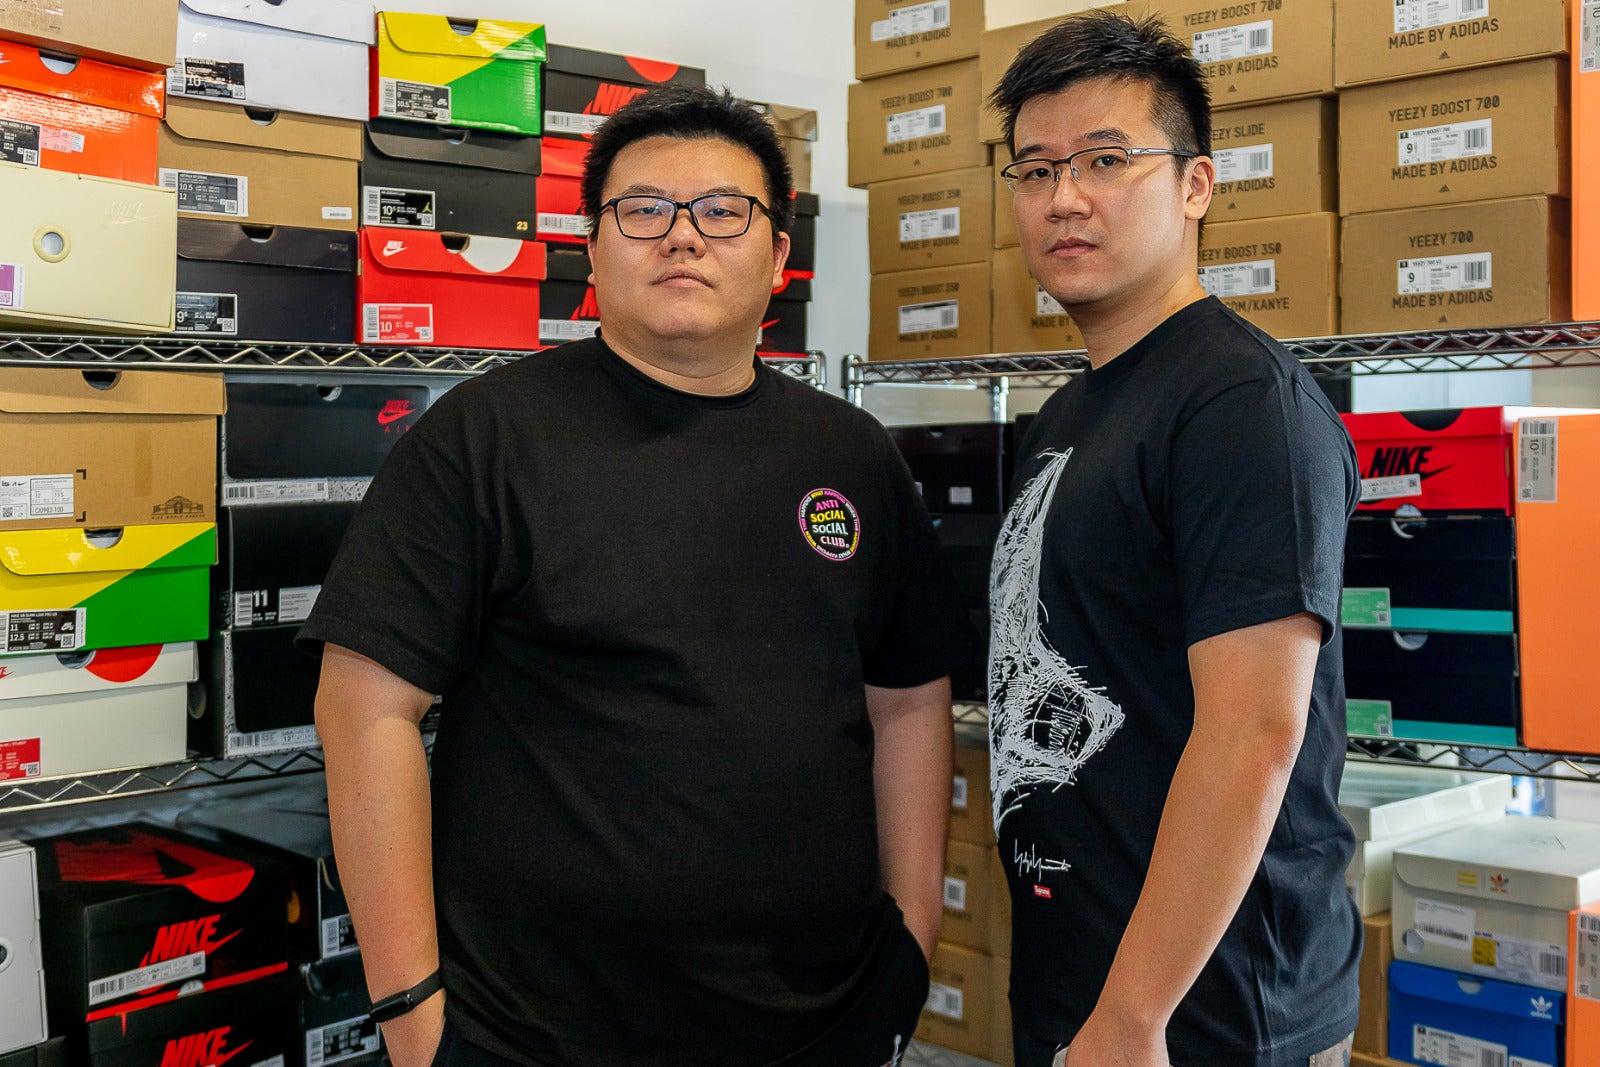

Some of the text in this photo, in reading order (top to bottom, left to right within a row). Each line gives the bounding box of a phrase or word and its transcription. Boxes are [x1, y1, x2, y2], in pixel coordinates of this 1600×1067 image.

[1184, 0, 1282, 26] YEEZY BOOST 700
[911, 34, 921, 45] BY
[922, 28, 951, 42] ADIDAS
[1389, 18, 1499, 49] MADE BY ADIDAS
[1220, 63, 1233, 77] BY
[1237, 56, 1279, 73] ADIDAS
[1389, 95, 1500, 122] YEEZY BOOST 700
[1235, 123, 1265, 138] SLIDE
[920, 135, 951, 150] ADIDAS
[1392, 156, 1497, 180] MADE BY ADIDAS
[1220, 182, 1233, 194] BY
[1237, 178, 1275, 192] ADIDAS
[517, 221, 528, 231] 23
[1408, 231, 1473, 248] YEEZY 700
[1224, 244, 1258, 259] BOOST
[1261, 242, 1282, 255] 350
[1408, 272, 1415, 283] 9
[1392, 289, 1493, 309] MADE BY ADIDAS
[380, 322, 392, 332] 10
[1368, 446, 1433, 478] NIKE
[816, 499, 840, 511] ANTI
[810, 510, 846, 523] SOCIAL
[812, 522, 849, 535] SOCIAL
[253, 589, 268, 607] 11
[150, 913, 222, 963] NIKE
[161, 1025, 231, 1067] NIKE
